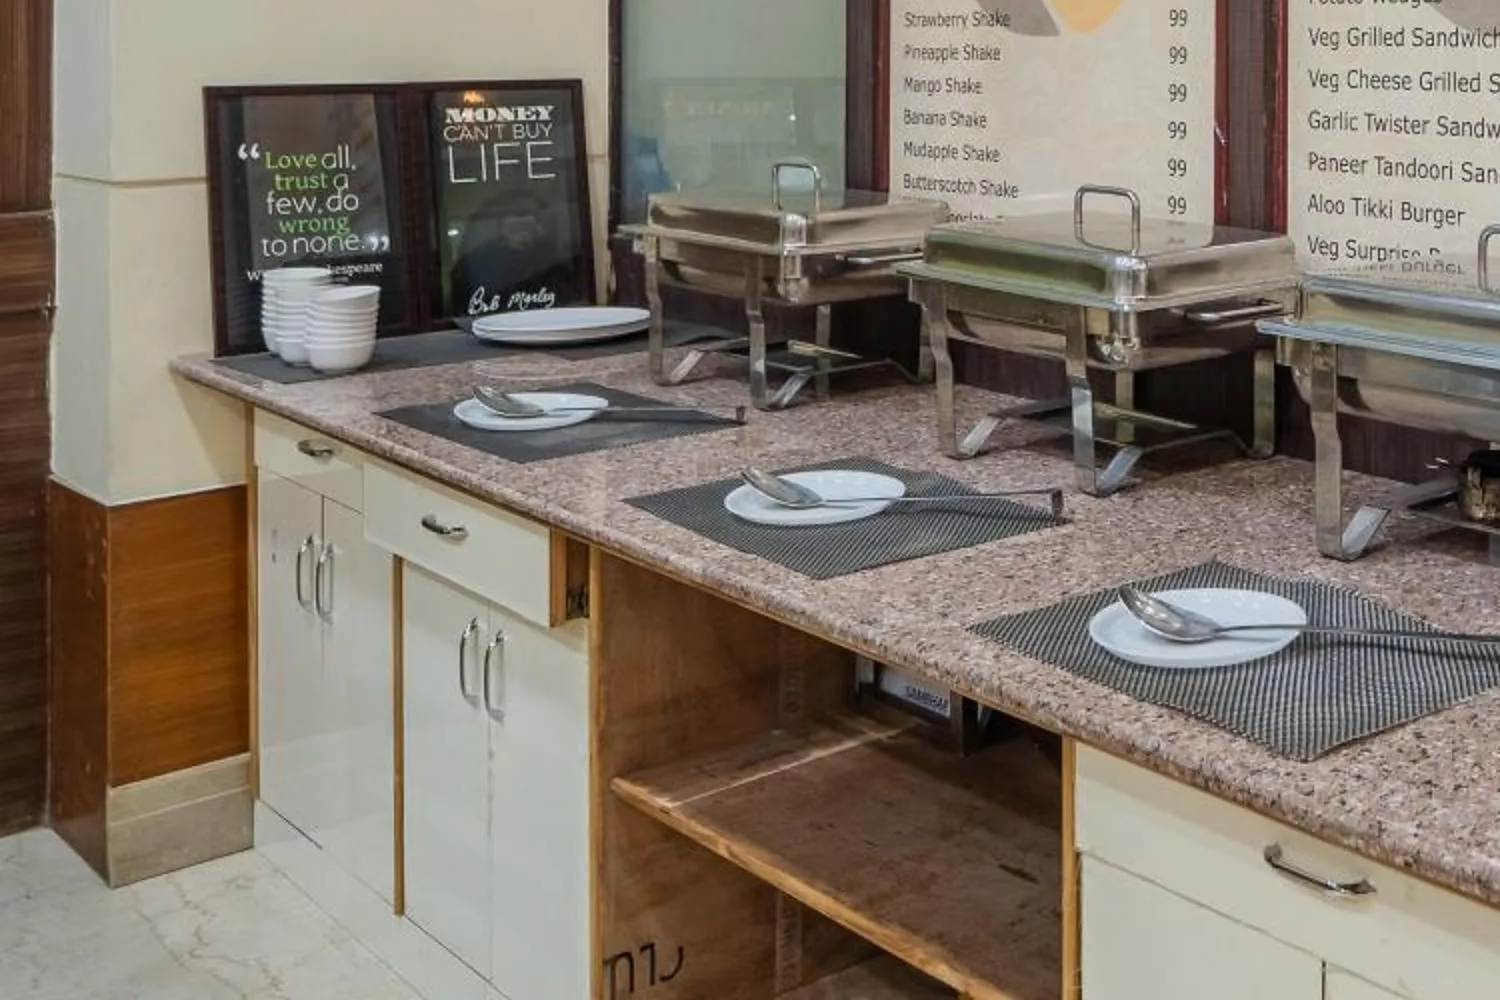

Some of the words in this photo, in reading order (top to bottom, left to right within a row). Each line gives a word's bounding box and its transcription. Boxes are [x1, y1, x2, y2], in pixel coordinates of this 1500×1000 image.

[1308, 27, 1339, 50] Veg
[1347, 26, 1404, 47] Grilled
[1169, 45, 1187, 64] 99
[1168, 83, 1187, 102] 99
[445, 106, 555, 123] MONEY
[444, 124, 506, 142] CAN'T
[513, 123, 552, 139] BUY
[448, 141, 556, 182] LIFE
[1167, 157, 1186, 176] 99
[1308, 151, 1368, 174] Paneer
[1373, 155, 1452, 180] Tandoori
[275, 172, 328, 190] trust
[333, 173, 348, 190] a
[326, 189, 359, 211] do
[1167, 195, 1186, 214] 99
[1307, 193, 1344, 214] Aloo
[1350, 197, 1392, 219] Tikki
[1401, 201, 1465, 229] Burger
[279, 216, 349, 235] wrong
[262, 238, 287, 257] to
[1307, 235, 1339, 261] Veg
